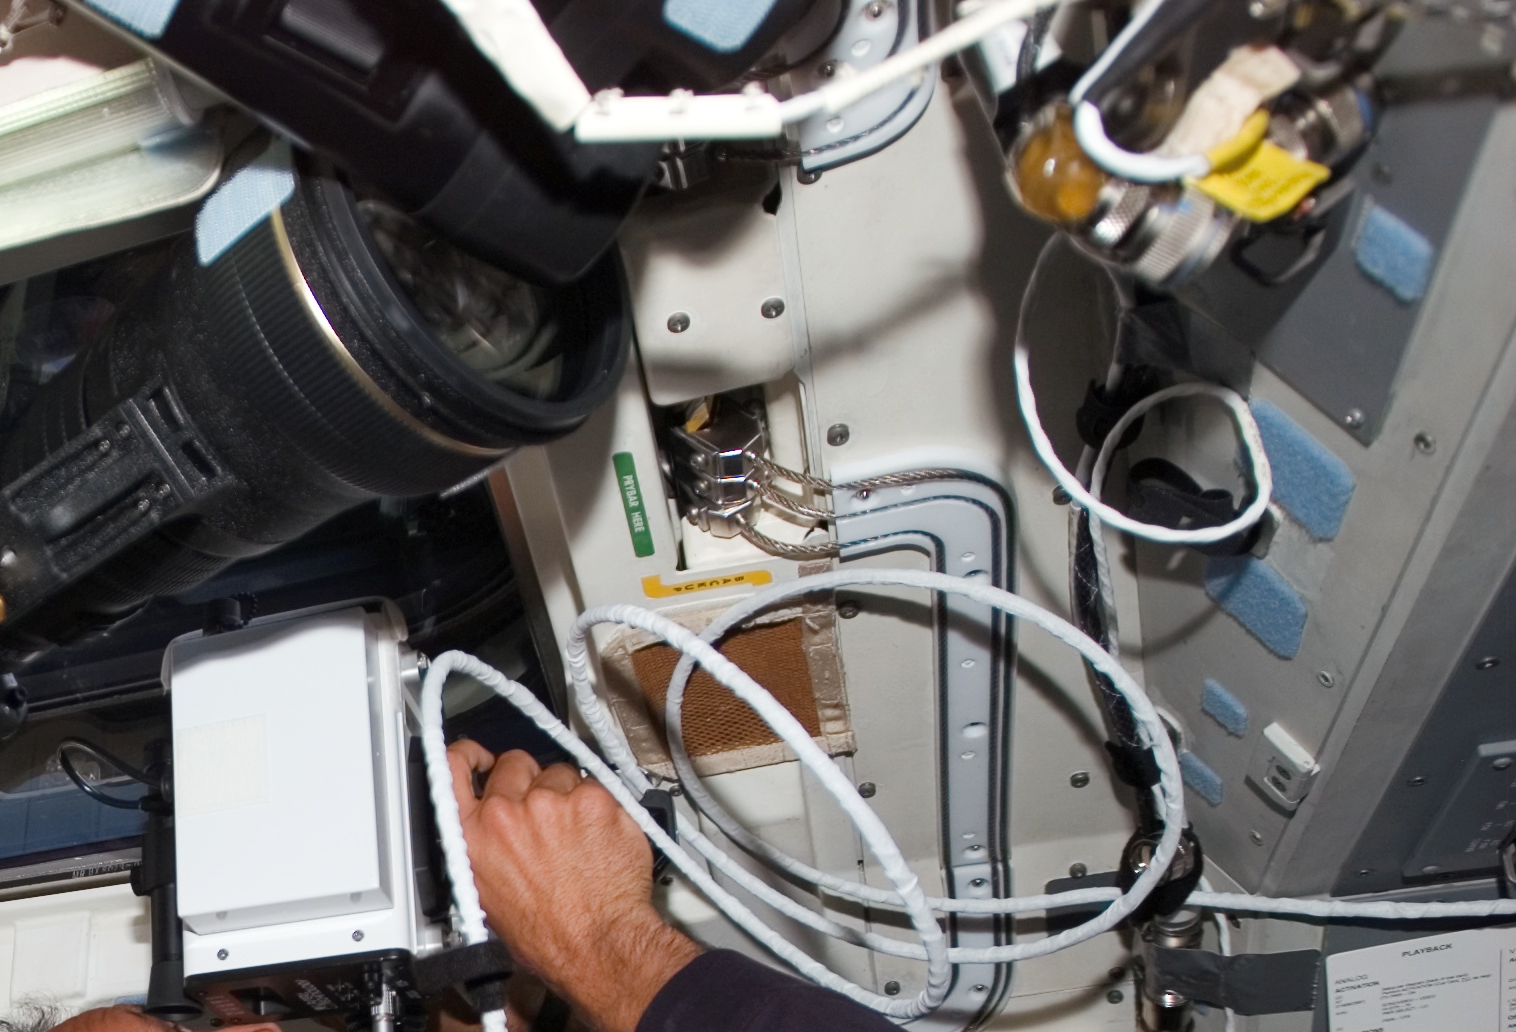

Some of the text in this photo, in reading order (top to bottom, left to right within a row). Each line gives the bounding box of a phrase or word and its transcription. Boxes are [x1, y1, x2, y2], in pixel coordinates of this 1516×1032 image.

[622, 475, 645, 533] PRYBAR HERE
[673, 575, 745, 592] BACKUP
[1401, 943, 1453, 958] PLAYBACK
[1335, 981, 1380, 993] ACTIVATION
